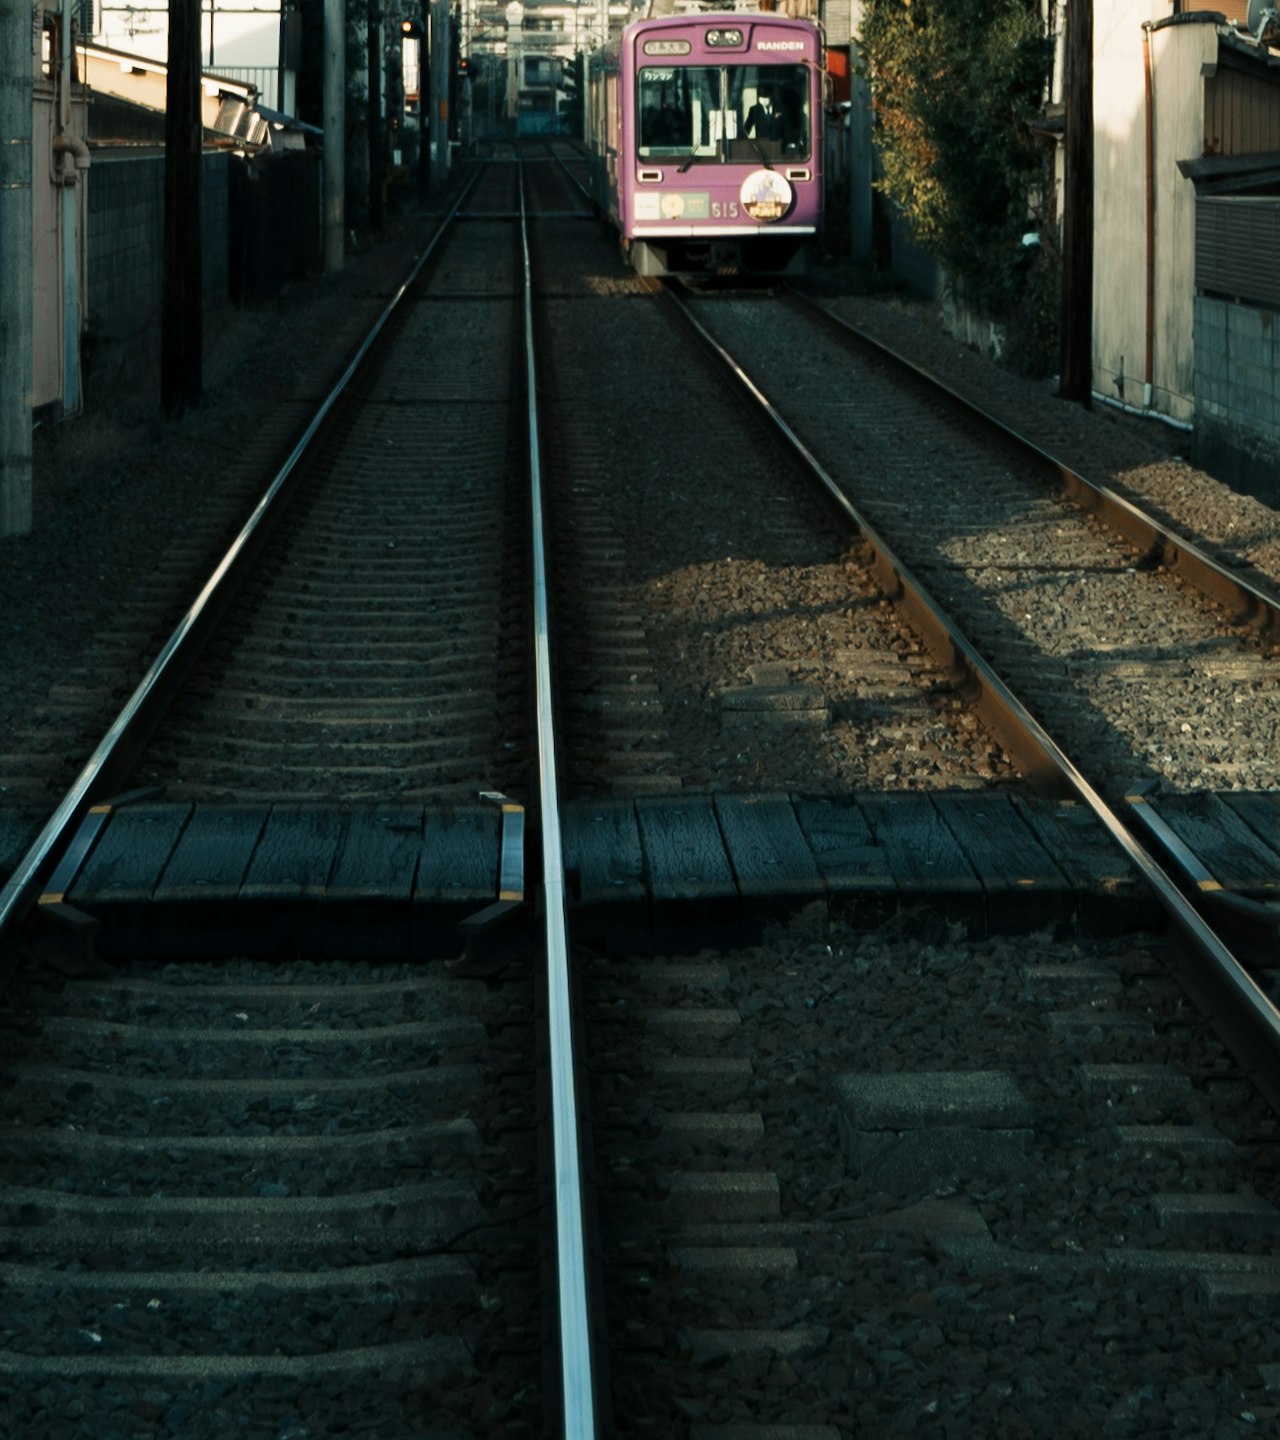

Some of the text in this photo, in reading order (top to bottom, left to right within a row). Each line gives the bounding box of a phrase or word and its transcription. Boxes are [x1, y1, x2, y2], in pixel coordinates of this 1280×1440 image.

[757, 41, 804, 51] RANDEN
[644, 70, 673, 81] ワンマン
